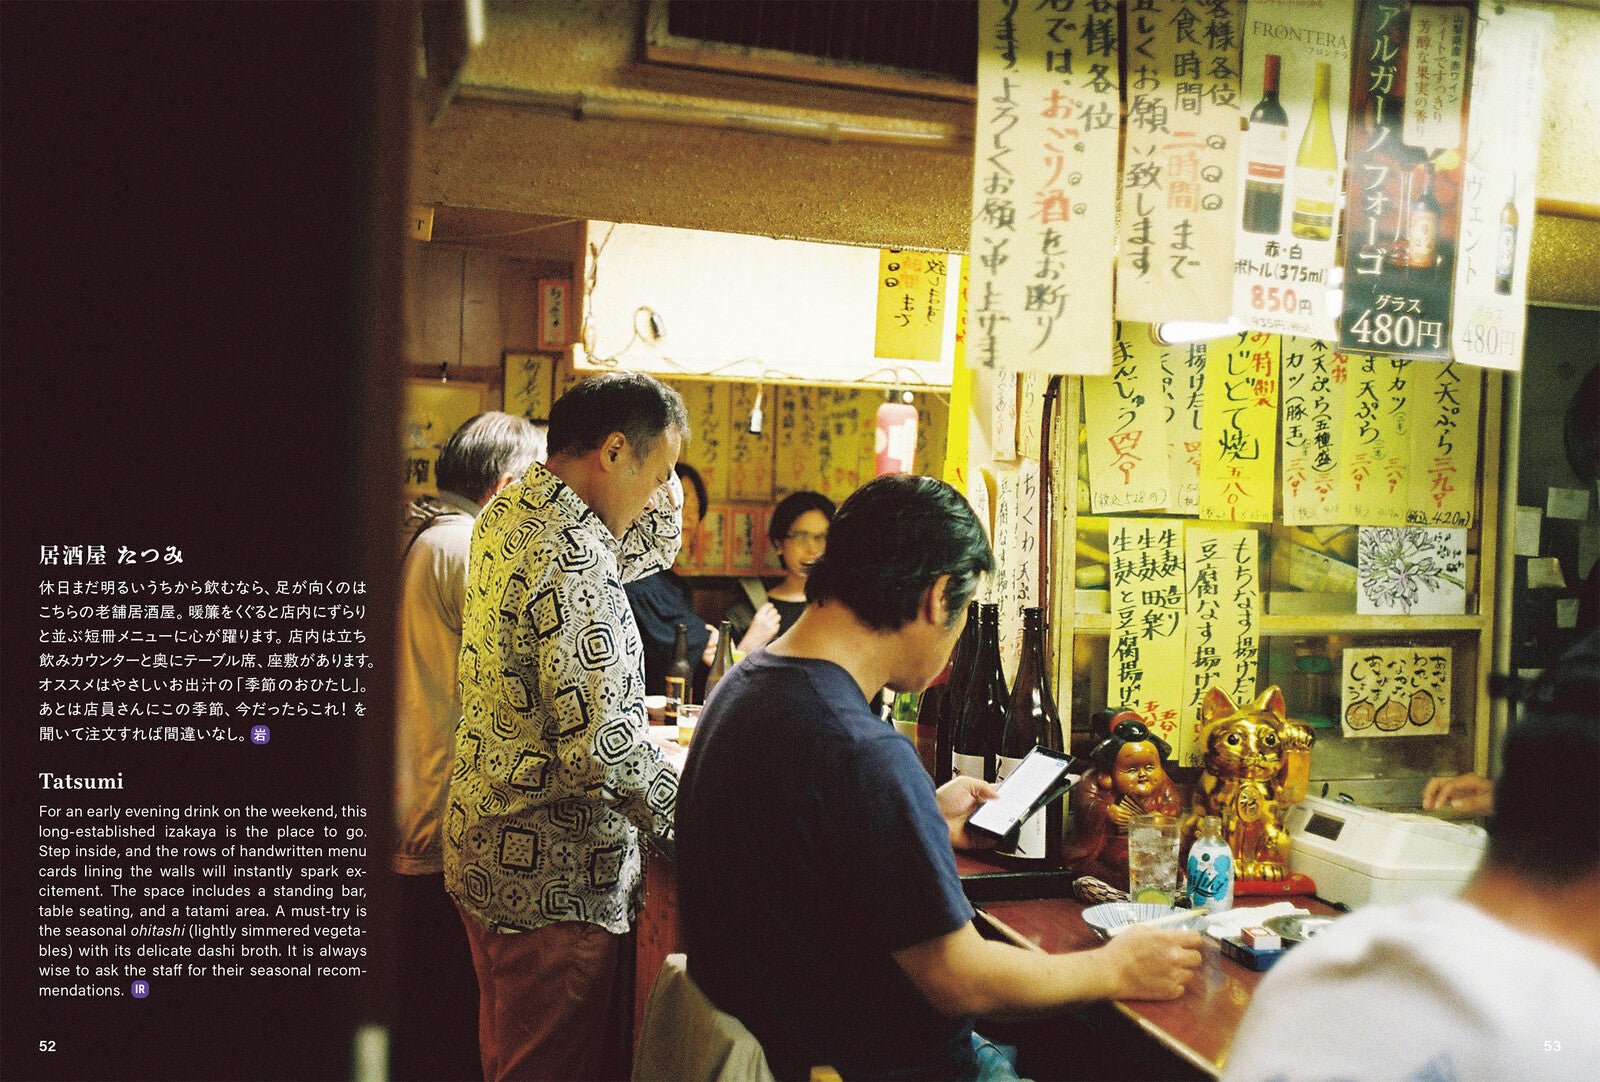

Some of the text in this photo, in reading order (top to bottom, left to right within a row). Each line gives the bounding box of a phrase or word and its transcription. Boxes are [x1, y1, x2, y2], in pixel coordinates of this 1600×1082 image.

[1252, 21, 1347, 49] FRONTERA
[1265, 241, 1303, 260] 赤・白
[1251, 284, 1313, 315] 850円
[1376, 293, 1422, 314] グラス
[1350, 309, 1443, 349] 480円
[1461, 320, 1515, 357] 480円
[1285, 335, 1309, 448] カツ(豚玉)
